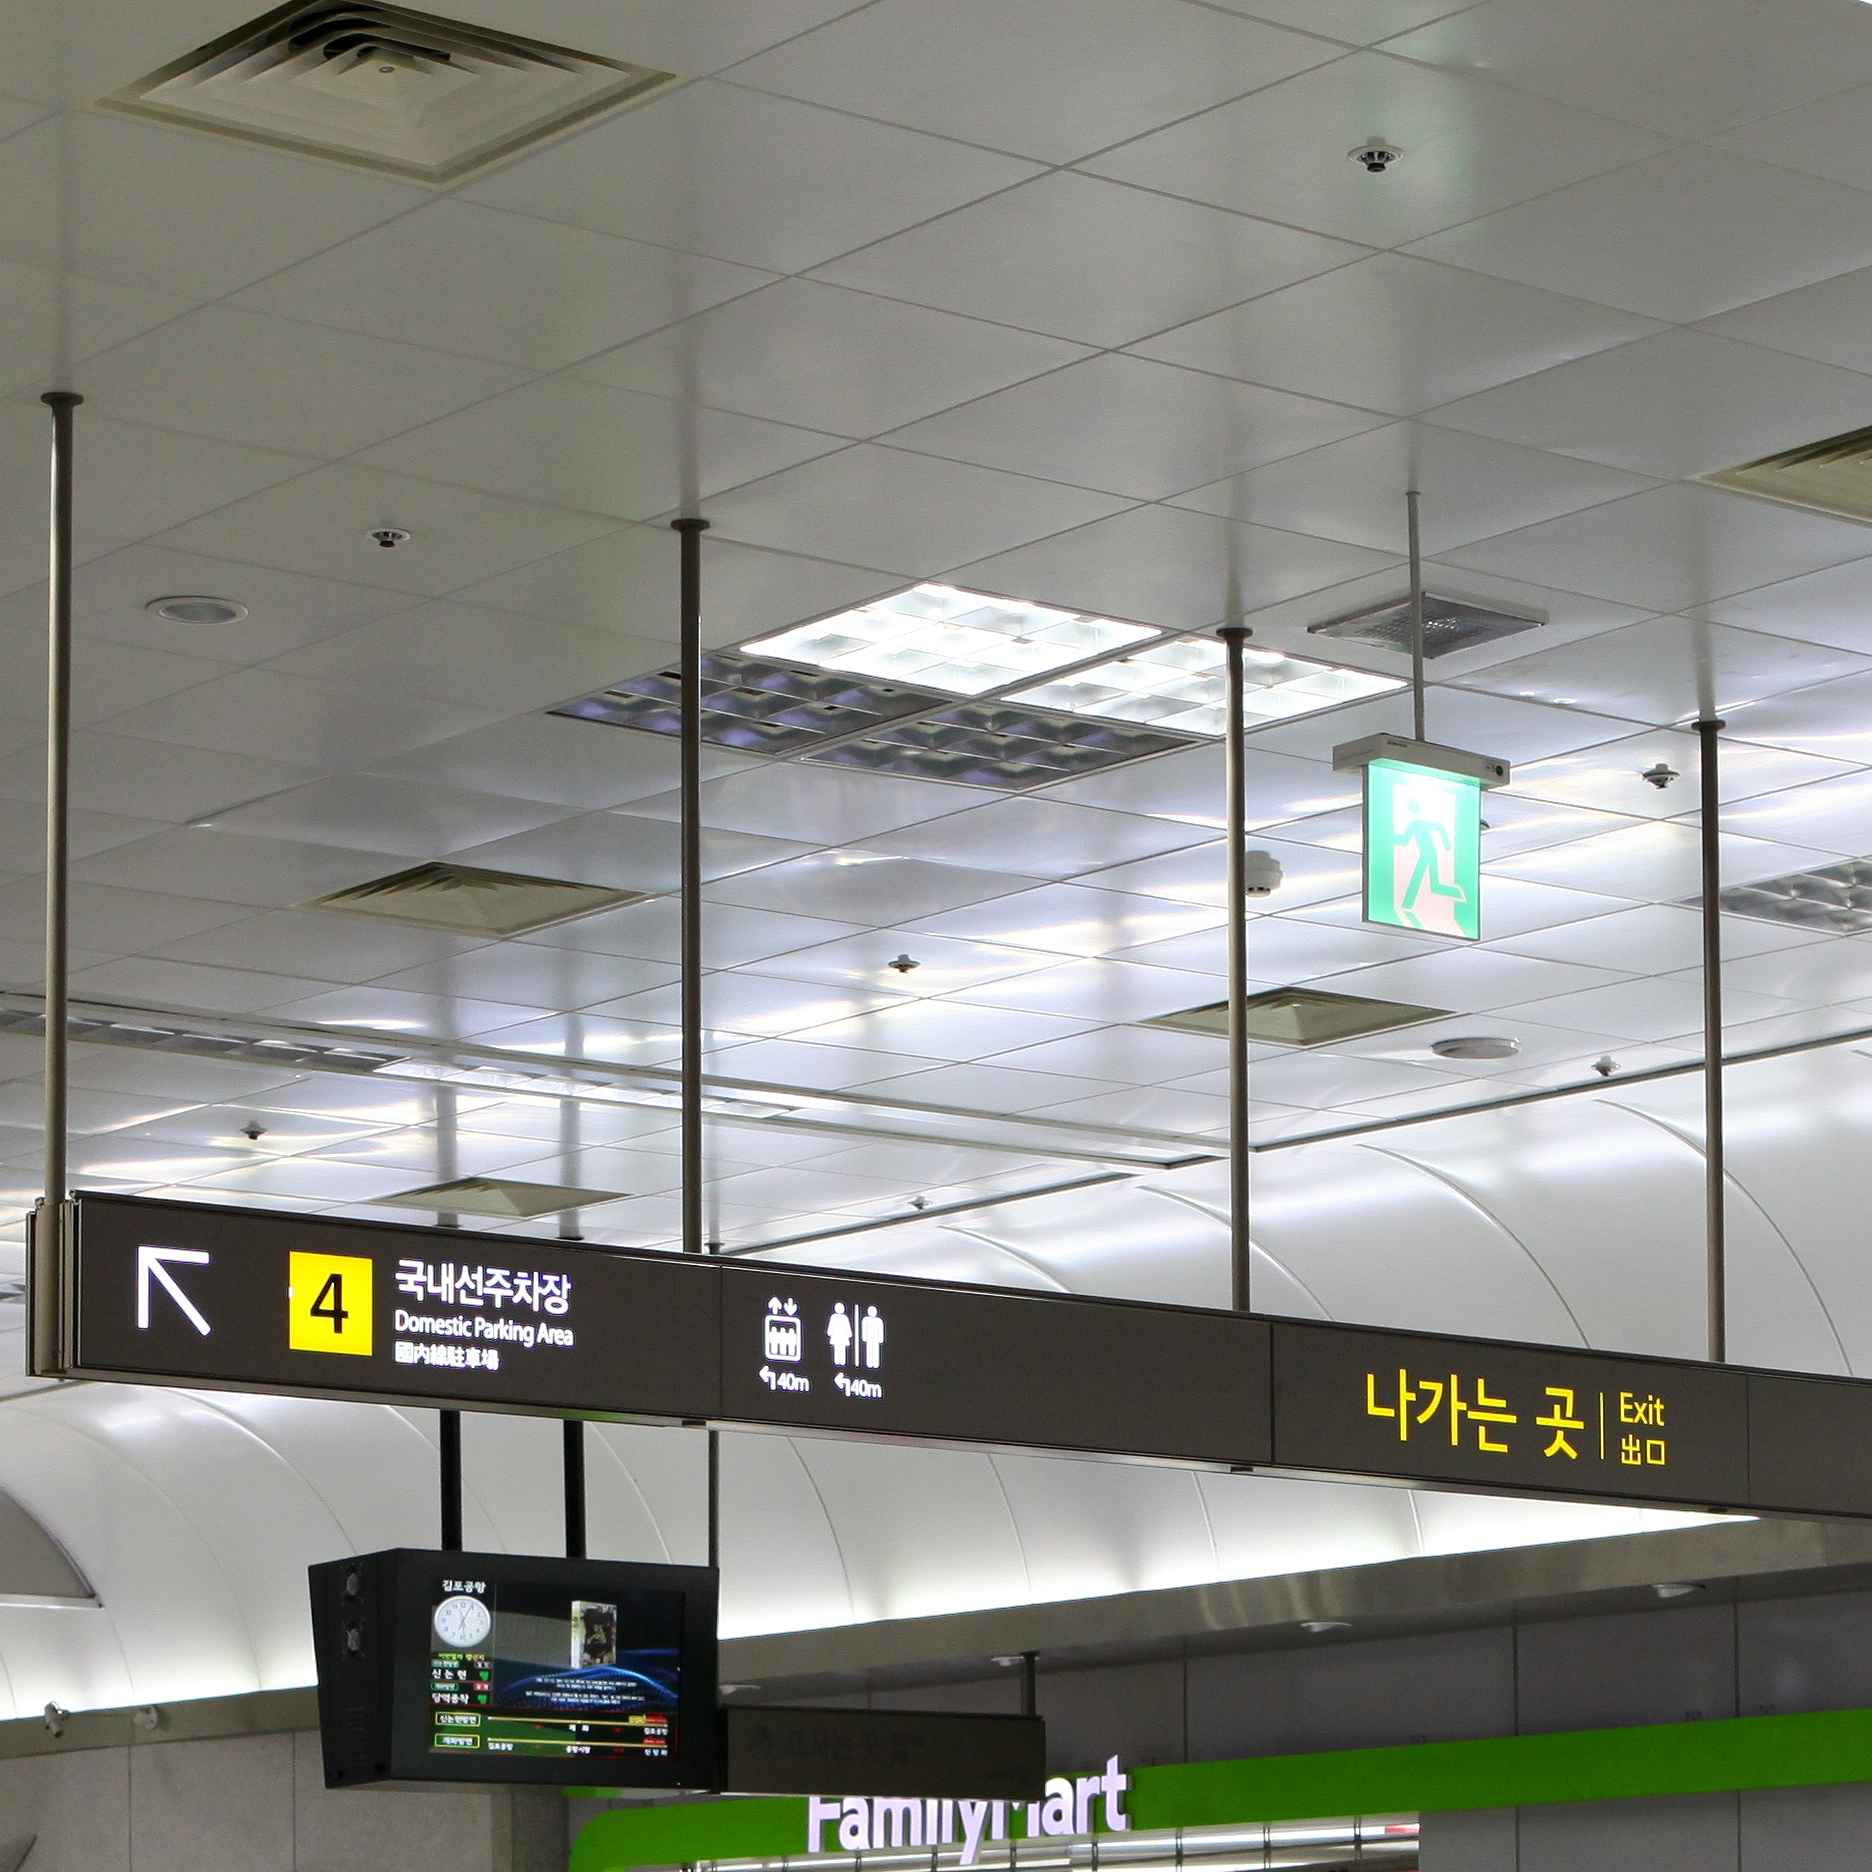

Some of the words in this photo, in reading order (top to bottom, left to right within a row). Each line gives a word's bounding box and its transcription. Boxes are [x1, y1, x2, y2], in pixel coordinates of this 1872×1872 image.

[309, 1273, 349, 1334] 4
[394, 1258, 572, 1315] 국내선주차장
[394, 1309, 472, 1338] Domestic
[475, 1316, 535, 1348] Parking
[536, 1322, 574, 1347] Area
[1366, 1368, 1517, 1454] 나가는
[1535, 1386, 1585, 1460] 곳
[1620, 1391, 1665, 1427] Exit
[1621, 1434, 1665, 1466] 出口
[443, 1579, 486, 1594] 김포공항
